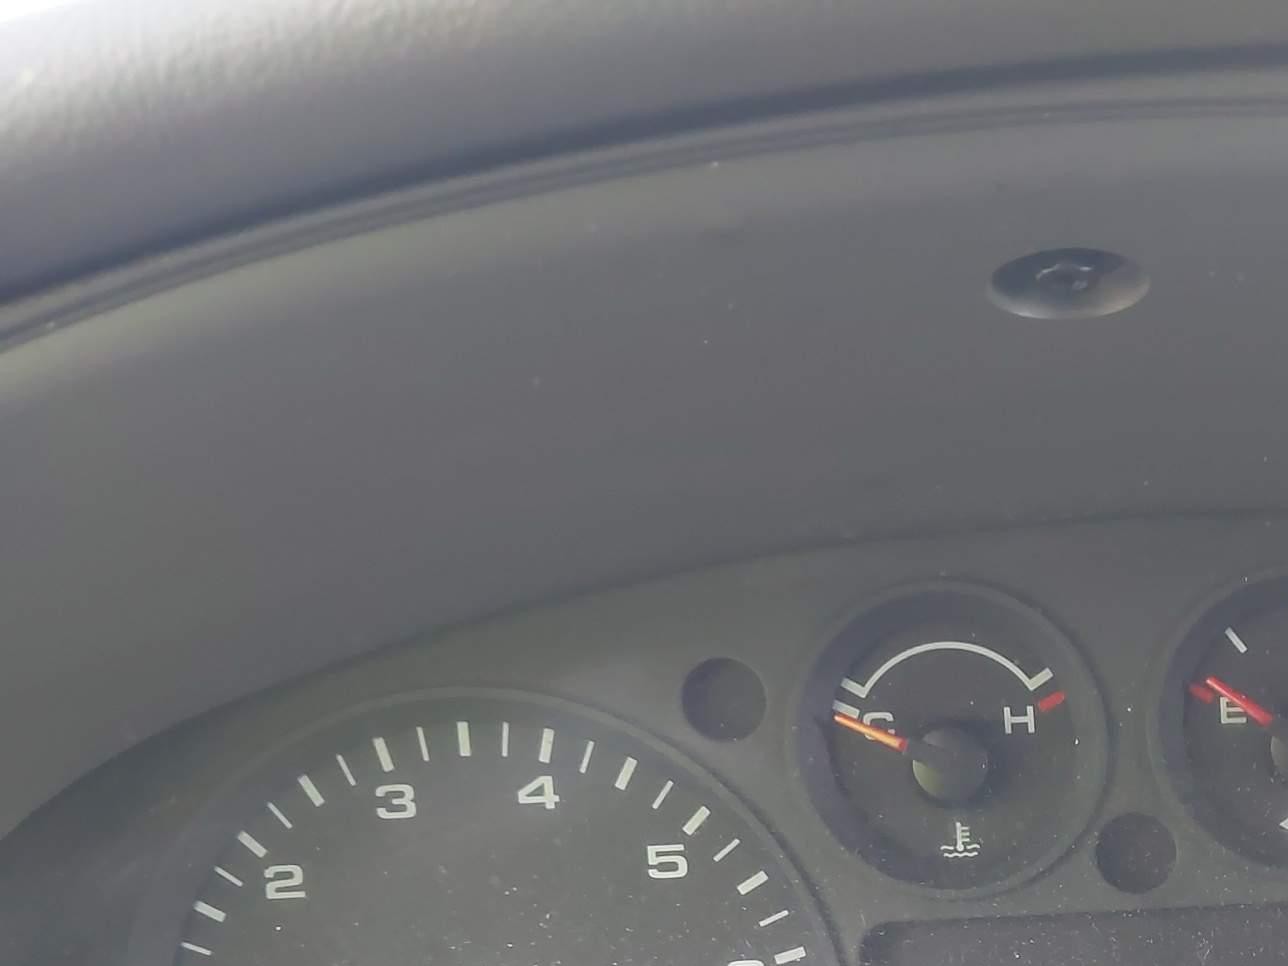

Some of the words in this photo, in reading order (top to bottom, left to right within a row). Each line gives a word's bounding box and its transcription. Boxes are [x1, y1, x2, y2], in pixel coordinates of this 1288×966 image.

[1004, 706, 1035, 733] H
[1220, 696, 1247, 724] E
[376, 784, 416, 819] 3
[517, 776, 560, 809] 4
[647, 845, 688, 878] 5
[264, 865, 306, 900] 2
